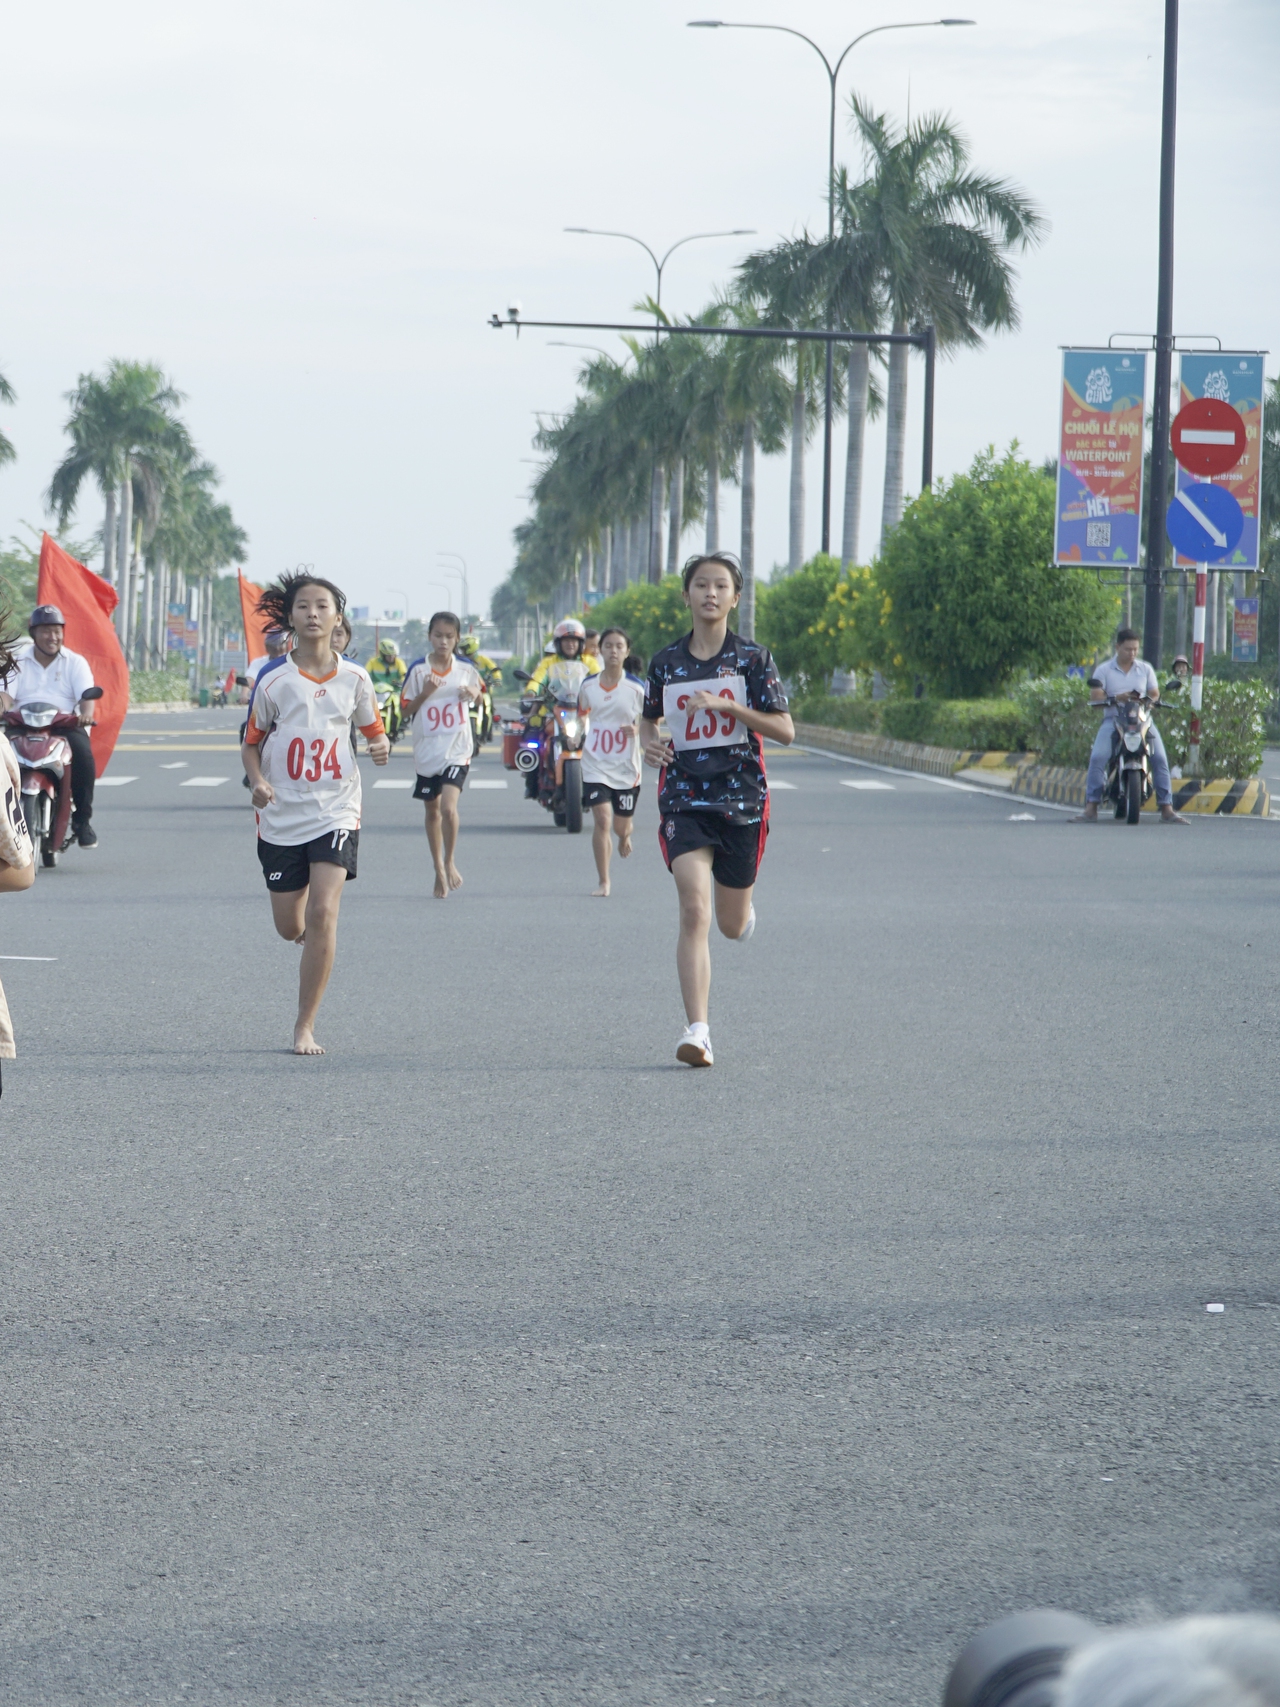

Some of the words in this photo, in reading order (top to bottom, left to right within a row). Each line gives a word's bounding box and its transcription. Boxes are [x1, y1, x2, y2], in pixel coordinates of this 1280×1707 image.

[1064, 419, 1100, 435] CHUỖI
[1119, 422, 1139, 439] HỘI
[1246, 424, 1257, 441] ỘI
[1065, 450, 1132, 462] WATERPOINT
[1086, 488, 1110, 517] HẾT
[427, 701, 466, 732] 961
[592, 728, 628, 755] 709
[287, 737, 342, 782] 034
[619, 794, 634, 811] 30
